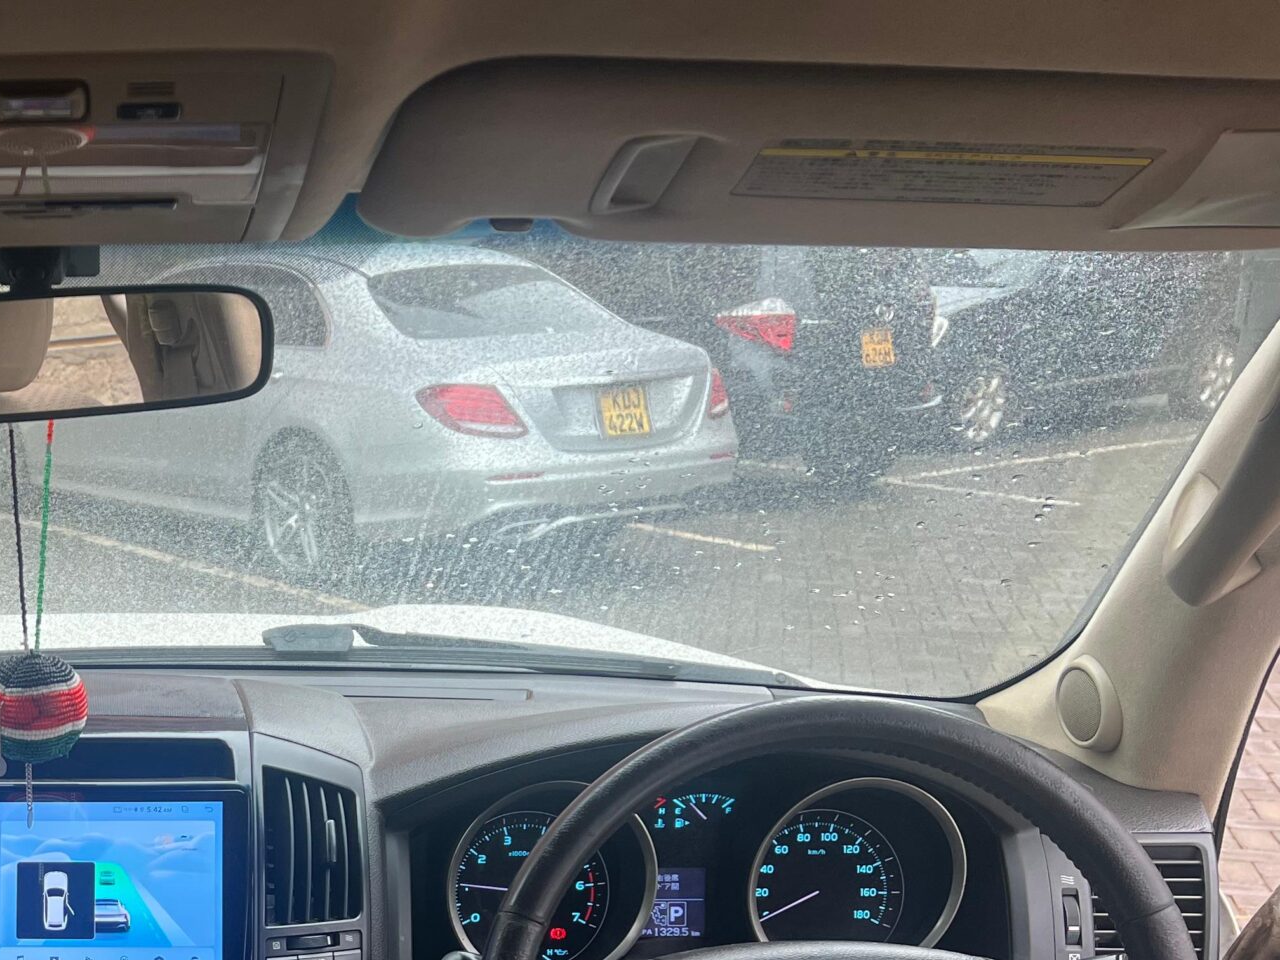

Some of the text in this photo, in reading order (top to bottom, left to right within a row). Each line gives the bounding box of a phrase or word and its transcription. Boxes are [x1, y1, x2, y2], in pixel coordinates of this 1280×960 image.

[503, 836, 512, 845] 3
[796, 833, 811, 842] 80
[821, 833, 838, 842] 100
[774, 845, 789, 854] 60
[843, 845, 860, 854] 120
[477, 855, 487, 864] 2
[760, 865, 774, 874] 40
[856, 865, 873, 874] 140
[575, 881, 585, 890] 6
[755, 888, 769, 897] 20
[860, 888, 877, 897] 160
[470, 913, 480, 922] 0
[571, 912, 581, 922] 7
[670, 906, 684, 922] P
[853, 910, 870, 919] 180
[654, 927, 689, 936] 1329.5
